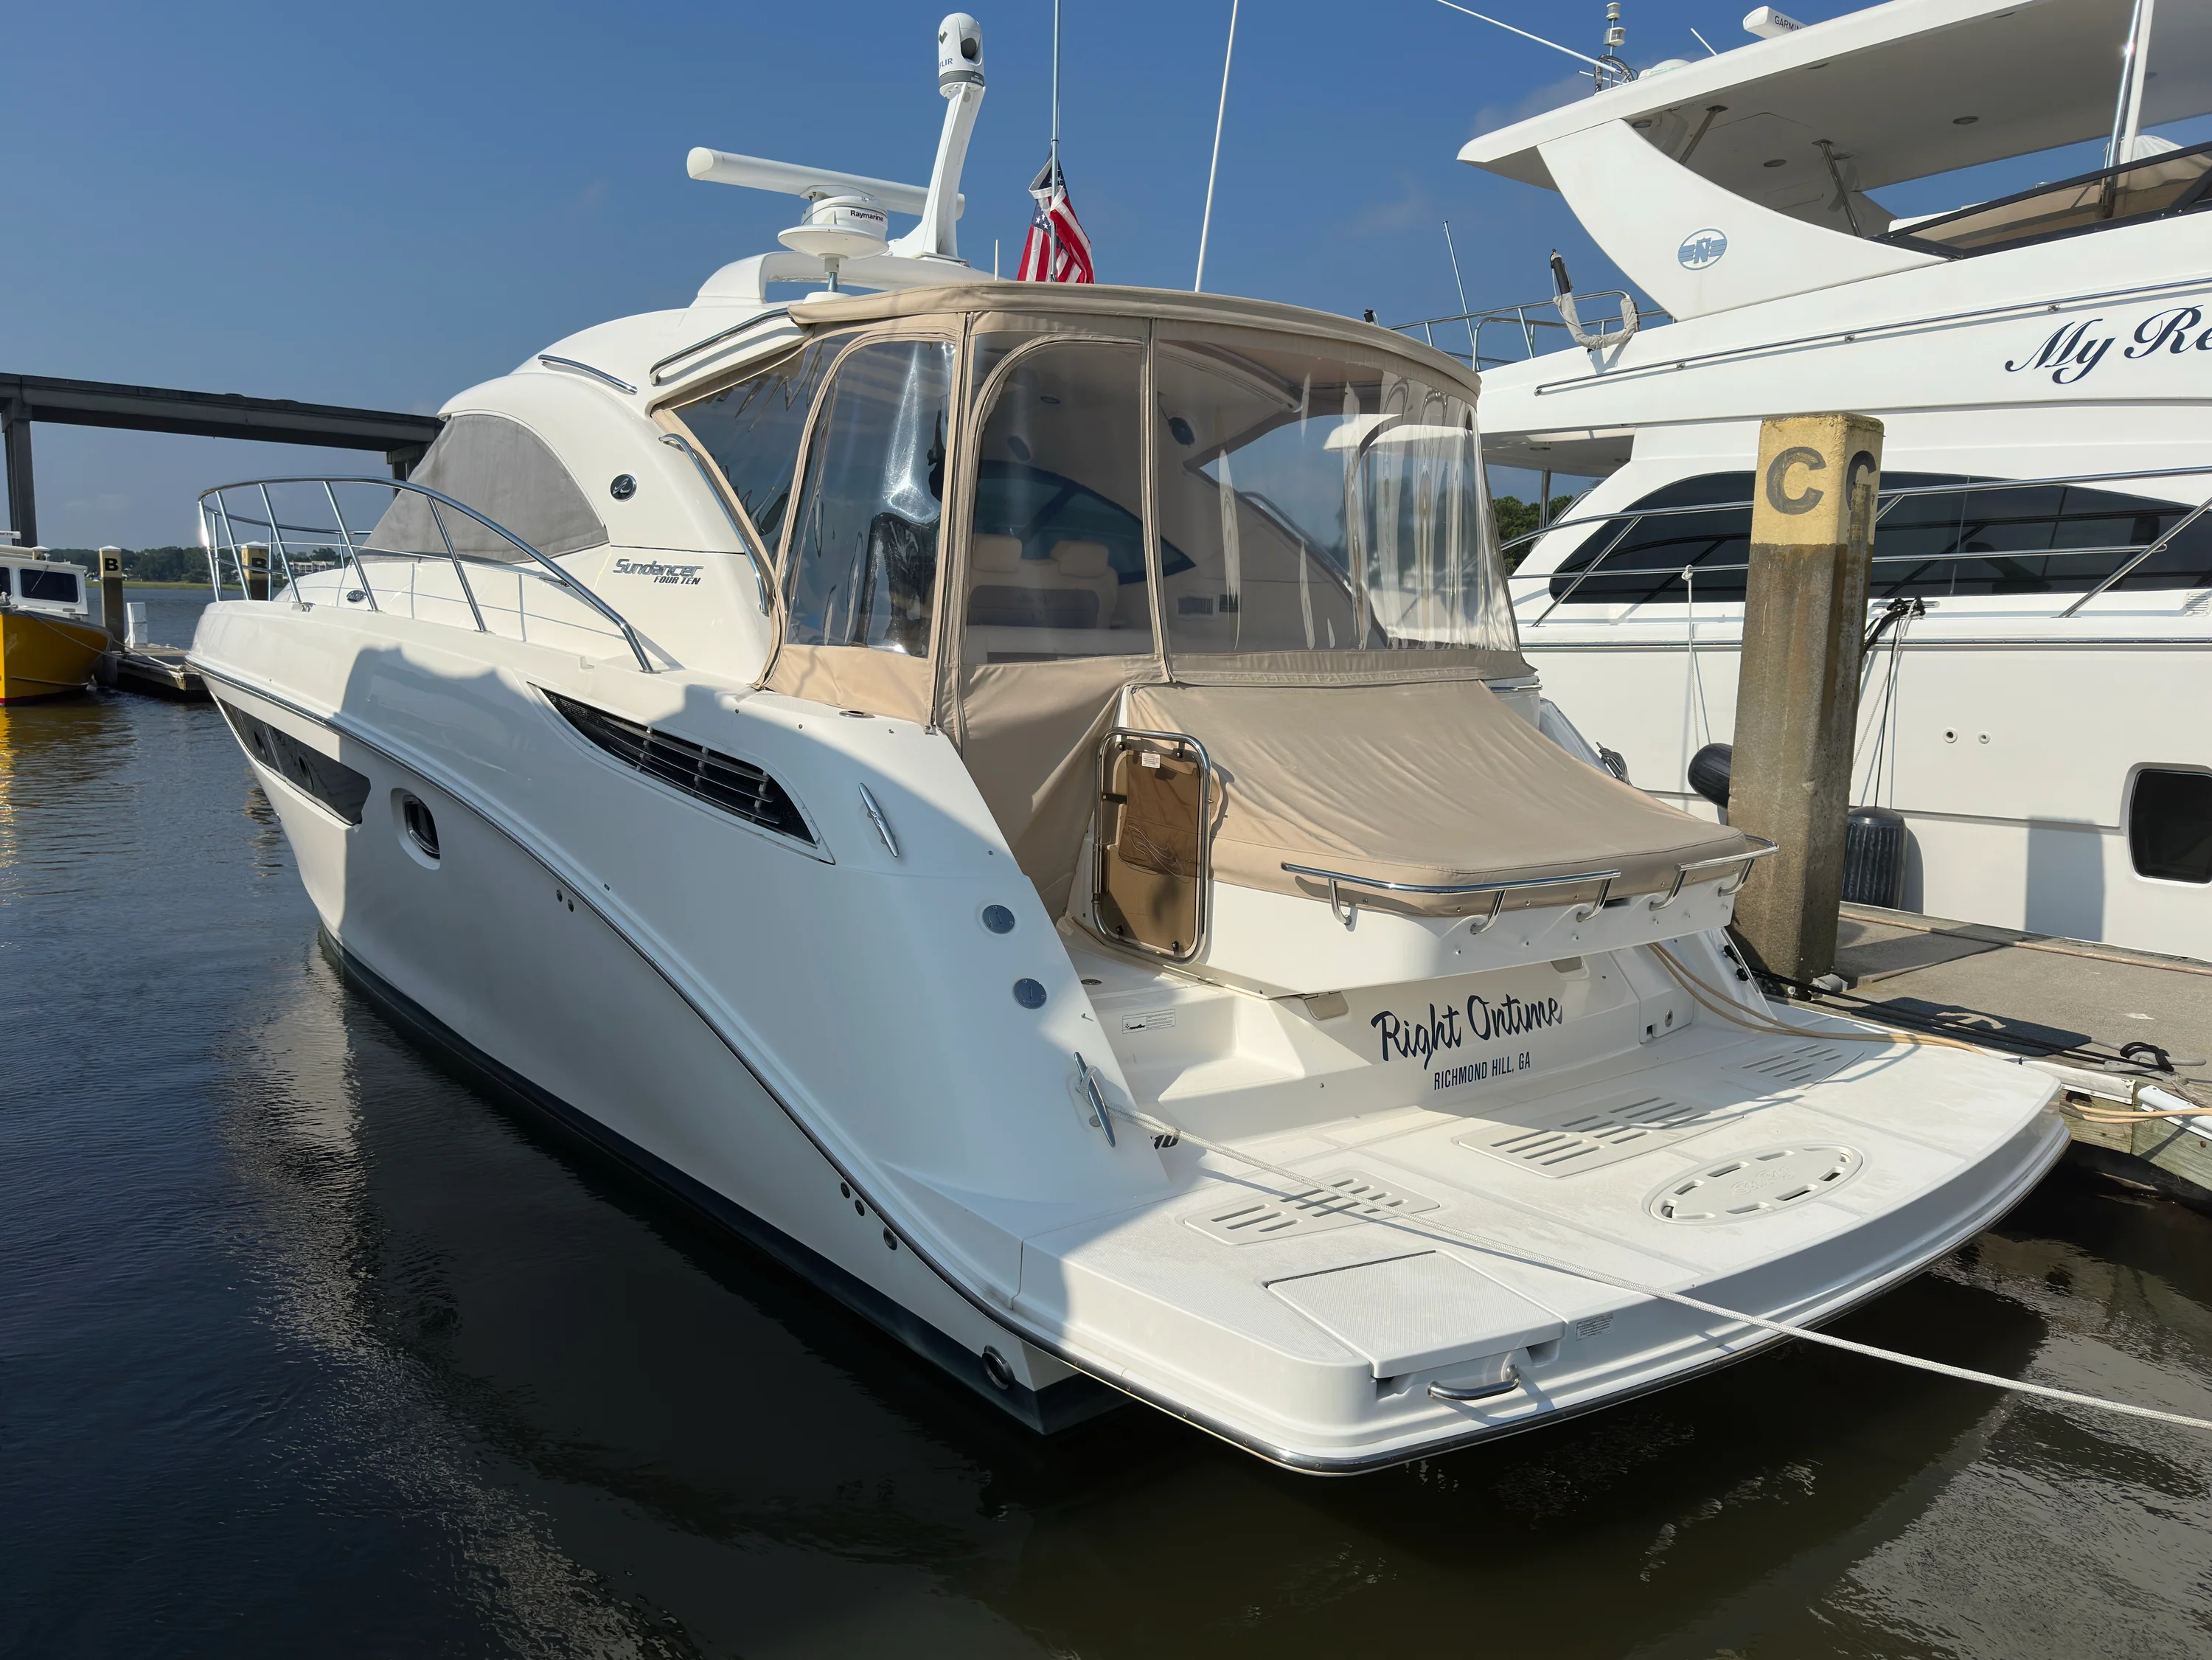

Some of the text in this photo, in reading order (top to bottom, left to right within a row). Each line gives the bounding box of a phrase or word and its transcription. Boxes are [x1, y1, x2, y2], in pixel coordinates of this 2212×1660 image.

[850, 209, 884, 222] Raymarine
[2004, 318, 2116, 385] My
[1766, 446, 1827, 515] C
[105, 558, 119, 572] B
[612, 558, 704, 577] Sundancer
[653, 575, 701, 586] FOUR TEN
[1370, 993, 1564, 1071] Right Ontime
[1433, 1051, 1531, 1091] RICHMOND HILL, GA
[1150, 1134, 1180, 1150] 10
